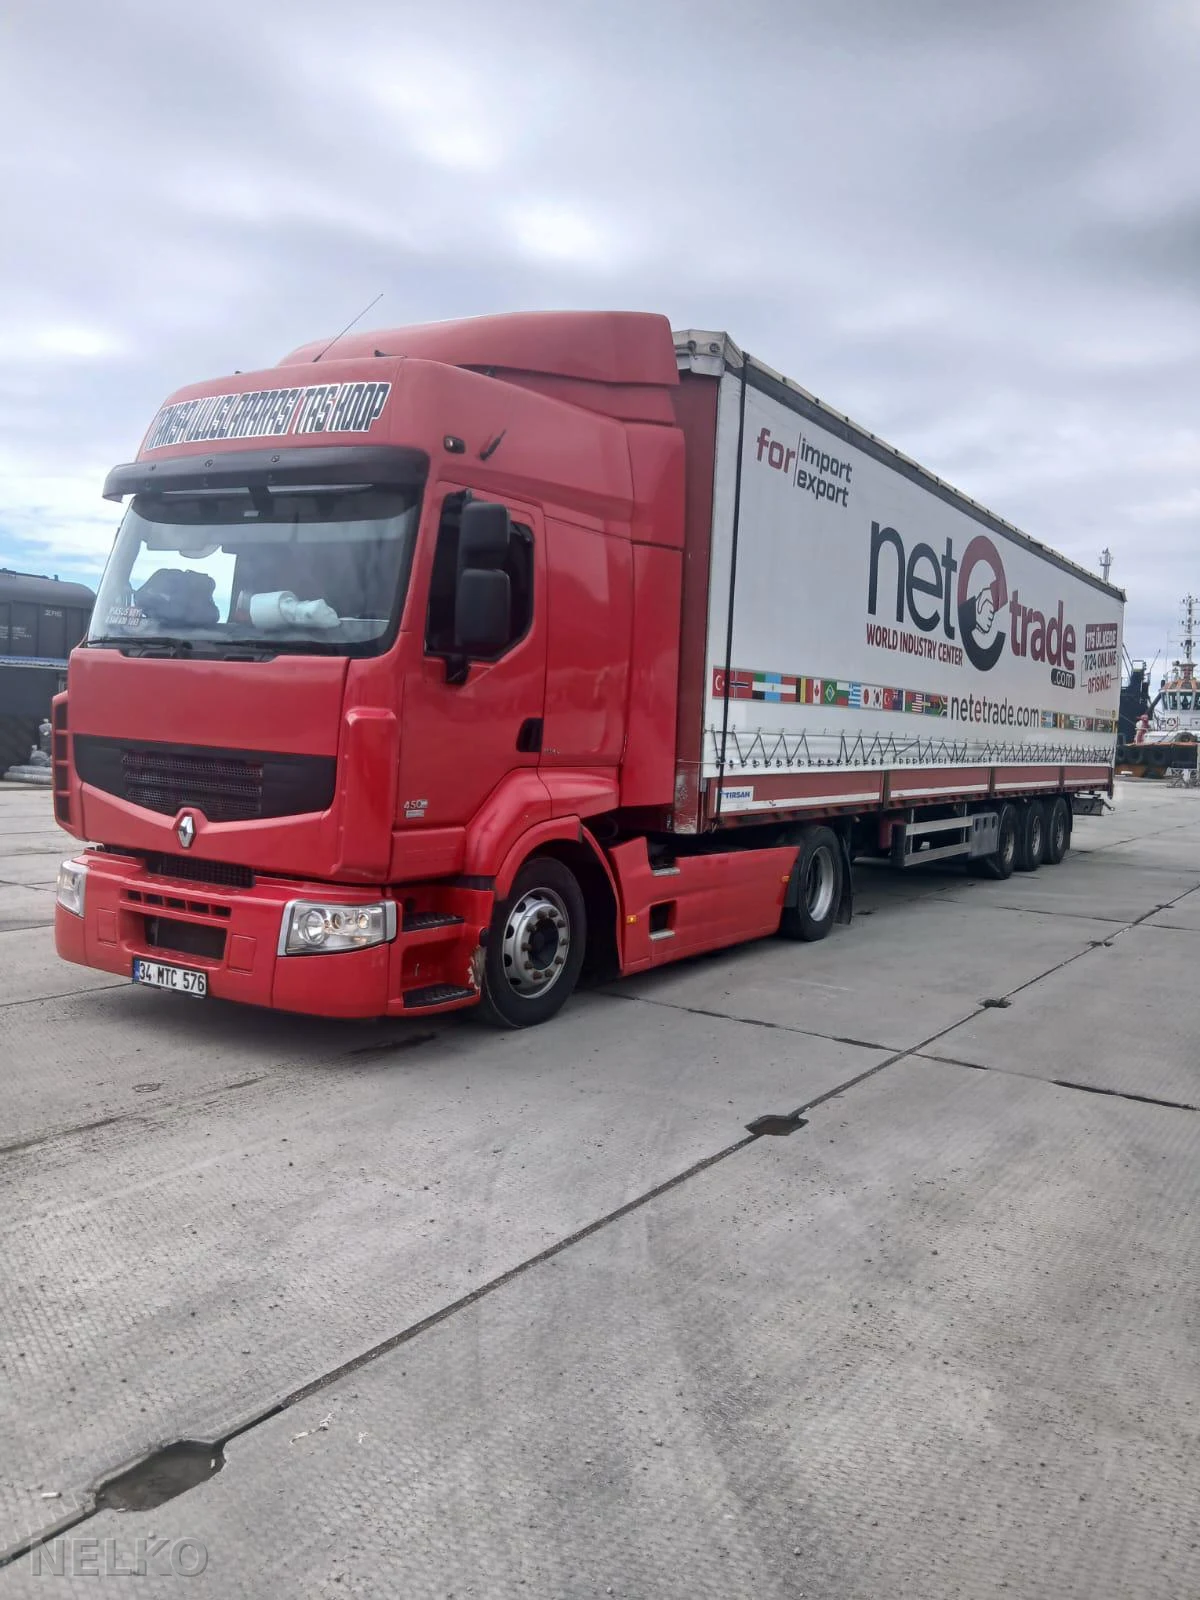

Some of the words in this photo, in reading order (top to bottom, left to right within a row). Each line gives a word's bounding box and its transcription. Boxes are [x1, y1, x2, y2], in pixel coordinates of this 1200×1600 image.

[757, 428, 795, 473] for
[801, 437, 852, 483] import
[797, 469, 849, 508] export
[866, 623, 898, 650] WORLD
[899, 631, 937, 660] INDUSTRY
[938, 642, 963, 667] CENTER
[1097, 651, 1117, 669] ONLINE
[1053, 671, 1074, 688] .com
[950, 693, 1040, 728] netetrade.com
[723, 791, 751, 799] TIRSAN
[139, 962, 152, 981] 34
[157, 967, 177, 987] MTC
[183, 971, 205, 992] 576
